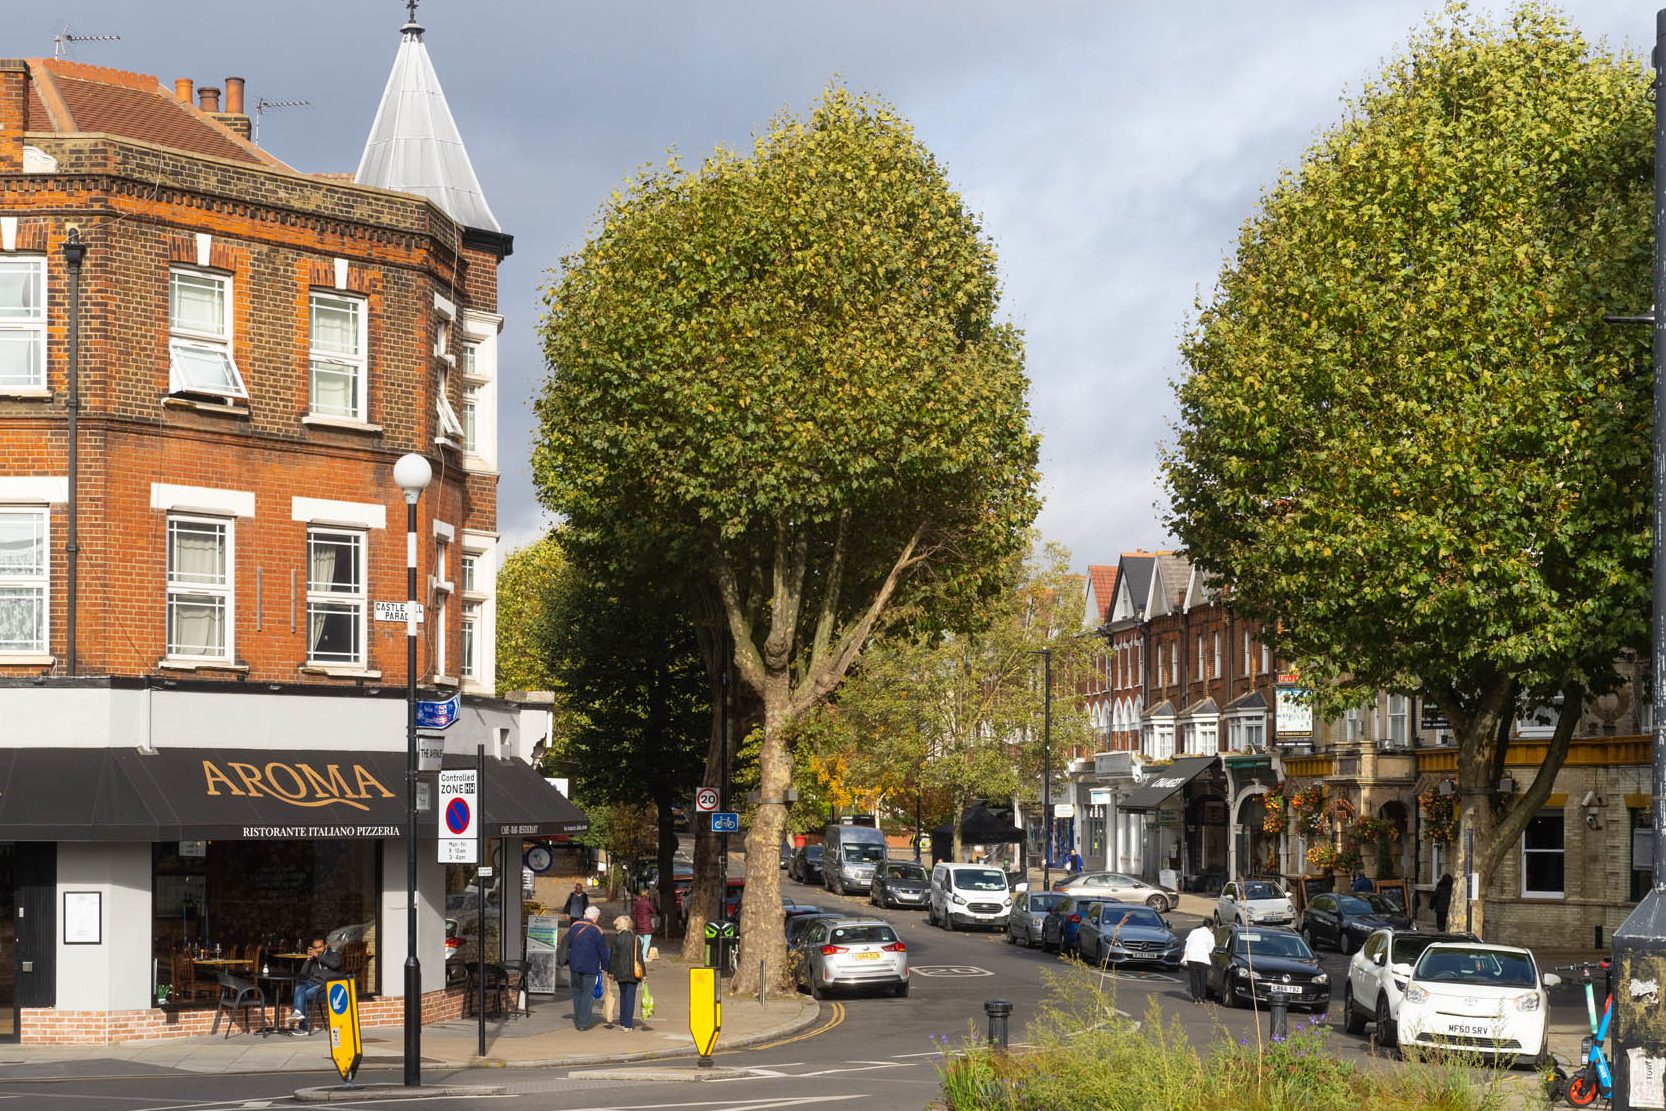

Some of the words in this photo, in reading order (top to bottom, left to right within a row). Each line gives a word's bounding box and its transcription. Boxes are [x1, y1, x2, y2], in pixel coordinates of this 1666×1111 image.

[376, 602, 405, 612] CASTLE
[385, 612, 408, 621] PARAD
[420, 749, 429, 758] THE
[440, 774, 475, 782] Controlled
[203, 760, 396, 811] AROMA
[441, 785, 464, 794] ZONE
[465, 783, 475, 794] HH
[701, 795, 716, 804] 20
[243, 827, 307, 837] RISTORANTE
[309, 827, 355, 837] ITALIANO
[357, 826, 400, 837] PIZZERIA
[1449, 1025, 1470, 1033] MF60
[1472, 1026, 1488, 1034] SRV
